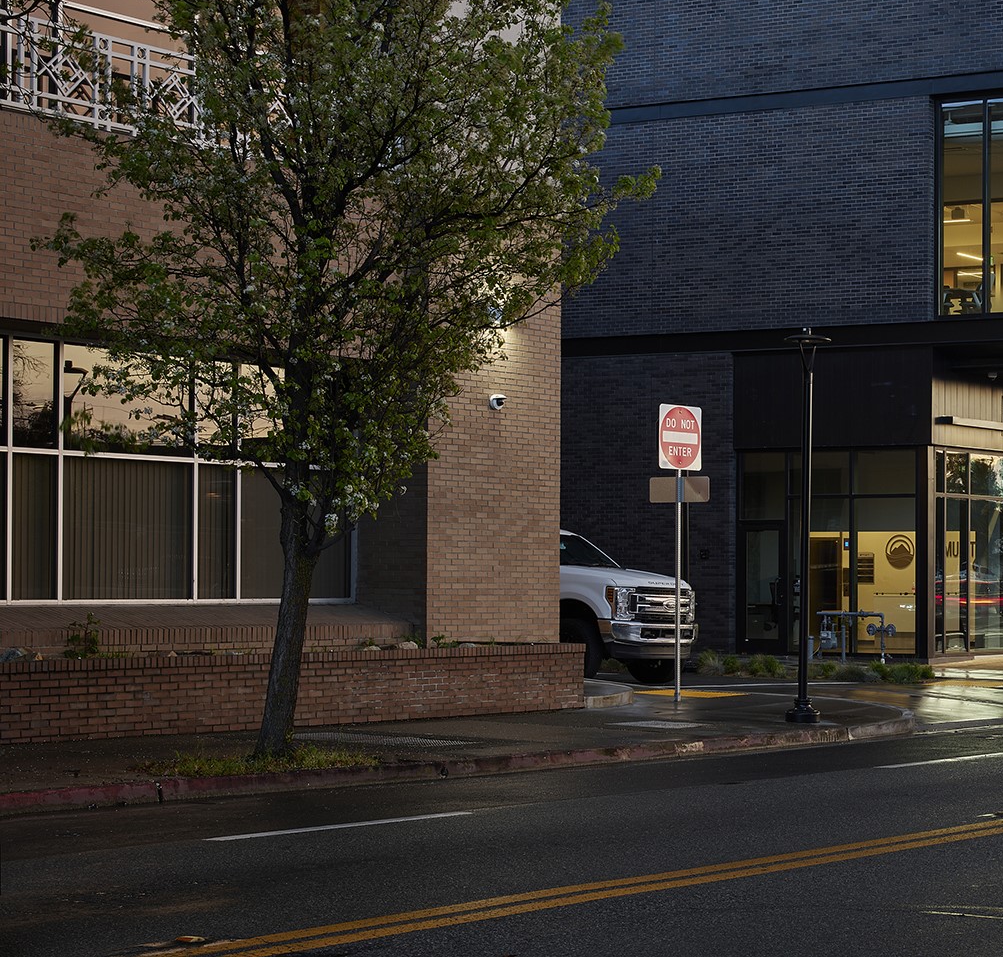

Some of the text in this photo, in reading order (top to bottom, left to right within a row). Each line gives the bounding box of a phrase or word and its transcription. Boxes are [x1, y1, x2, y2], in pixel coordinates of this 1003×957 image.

[666, 418, 695, 430] DO NOT
[668, 446, 692, 457] ENTER
